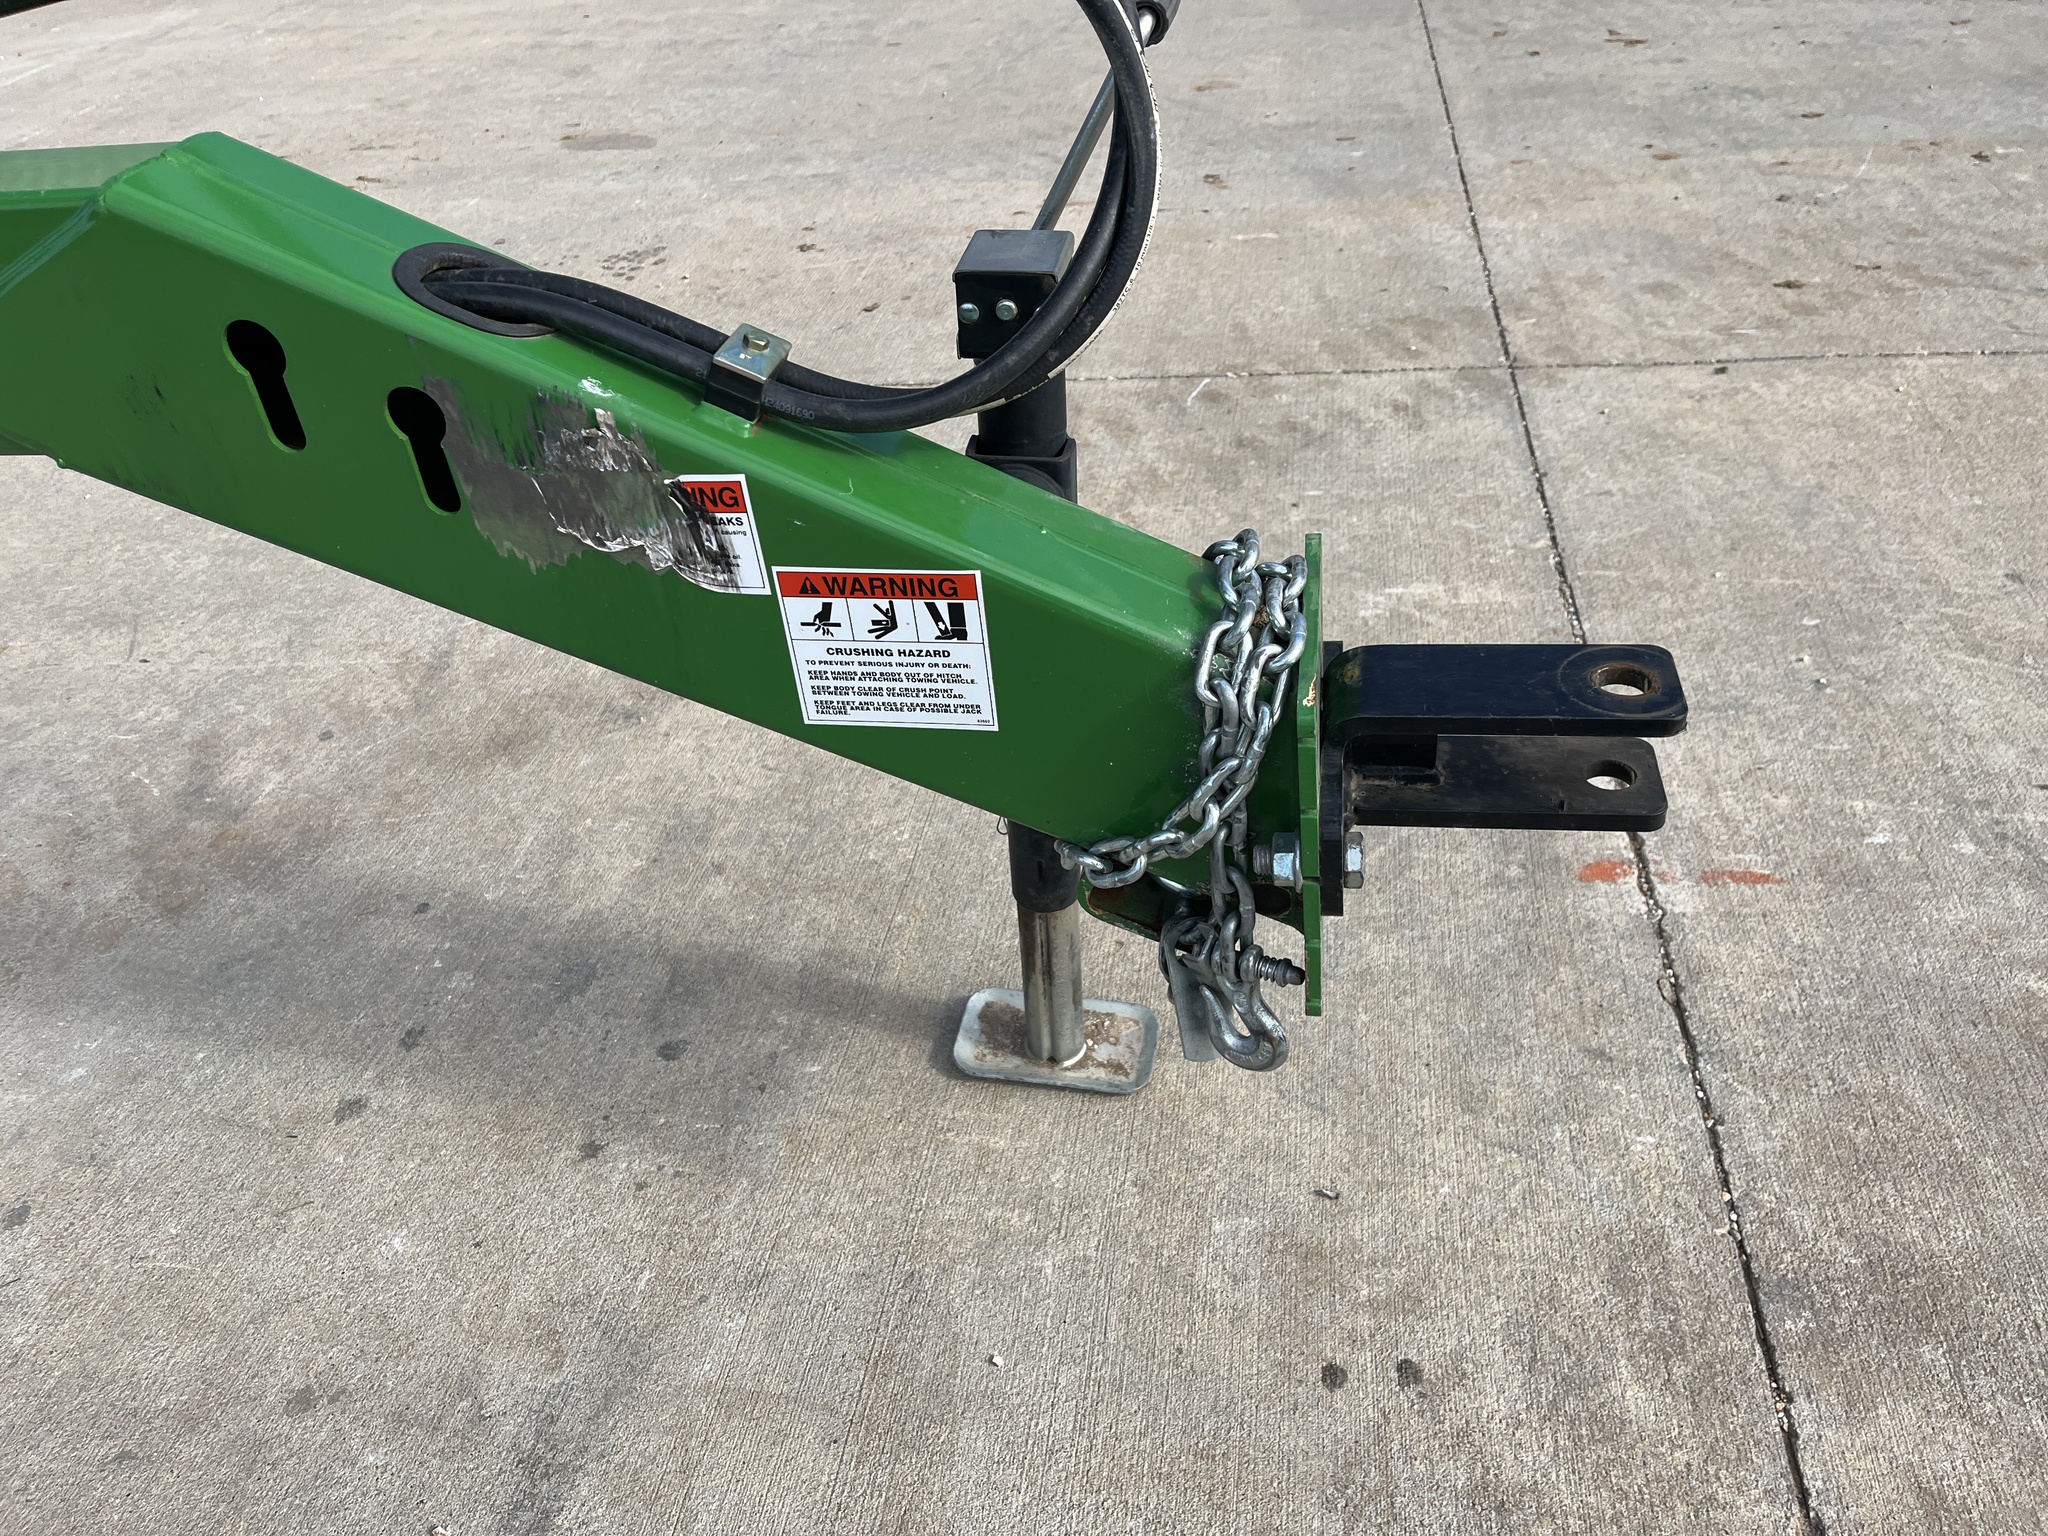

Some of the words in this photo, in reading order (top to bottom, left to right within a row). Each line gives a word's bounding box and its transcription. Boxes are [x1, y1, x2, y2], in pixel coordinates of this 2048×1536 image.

[822, 576, 958, 598] WARNING
[826, 647, 894, 657] CRUSHING
[897, 648, 951, 658] HAZARD
